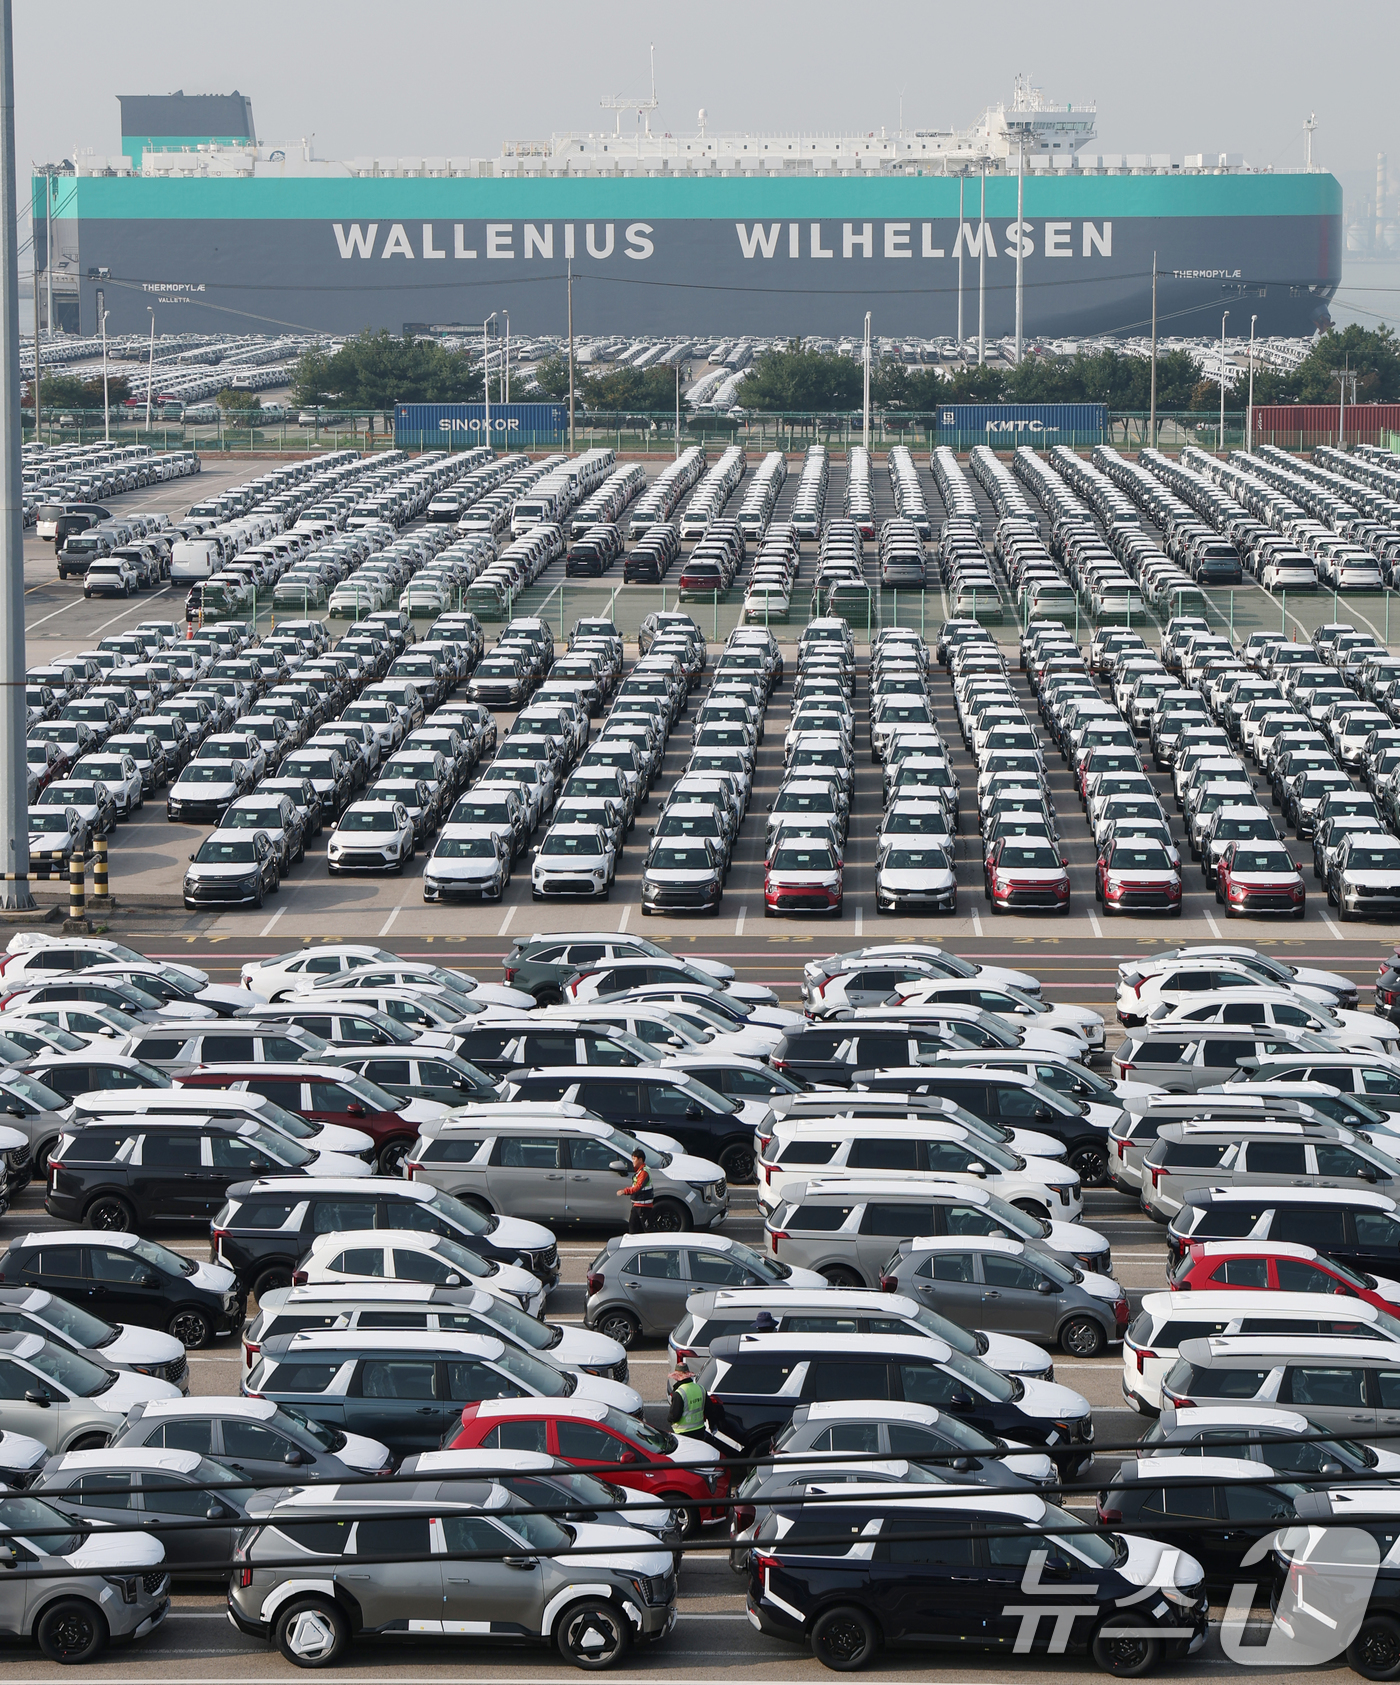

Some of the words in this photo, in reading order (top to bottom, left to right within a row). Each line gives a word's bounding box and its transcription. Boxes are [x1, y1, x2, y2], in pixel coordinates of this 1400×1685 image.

[332, 222, 655, 260] WALLENIUS
[735, 221, 1112, 259] WILHELMSEN
[1173, 269, 1241, 278] THERMOPYLÆ
[142, 283, 206, 292] THERMOPYLÆ
[438, 418, 519, 431] SINOKOR
[985, 420, 1043, 432] KMTC
